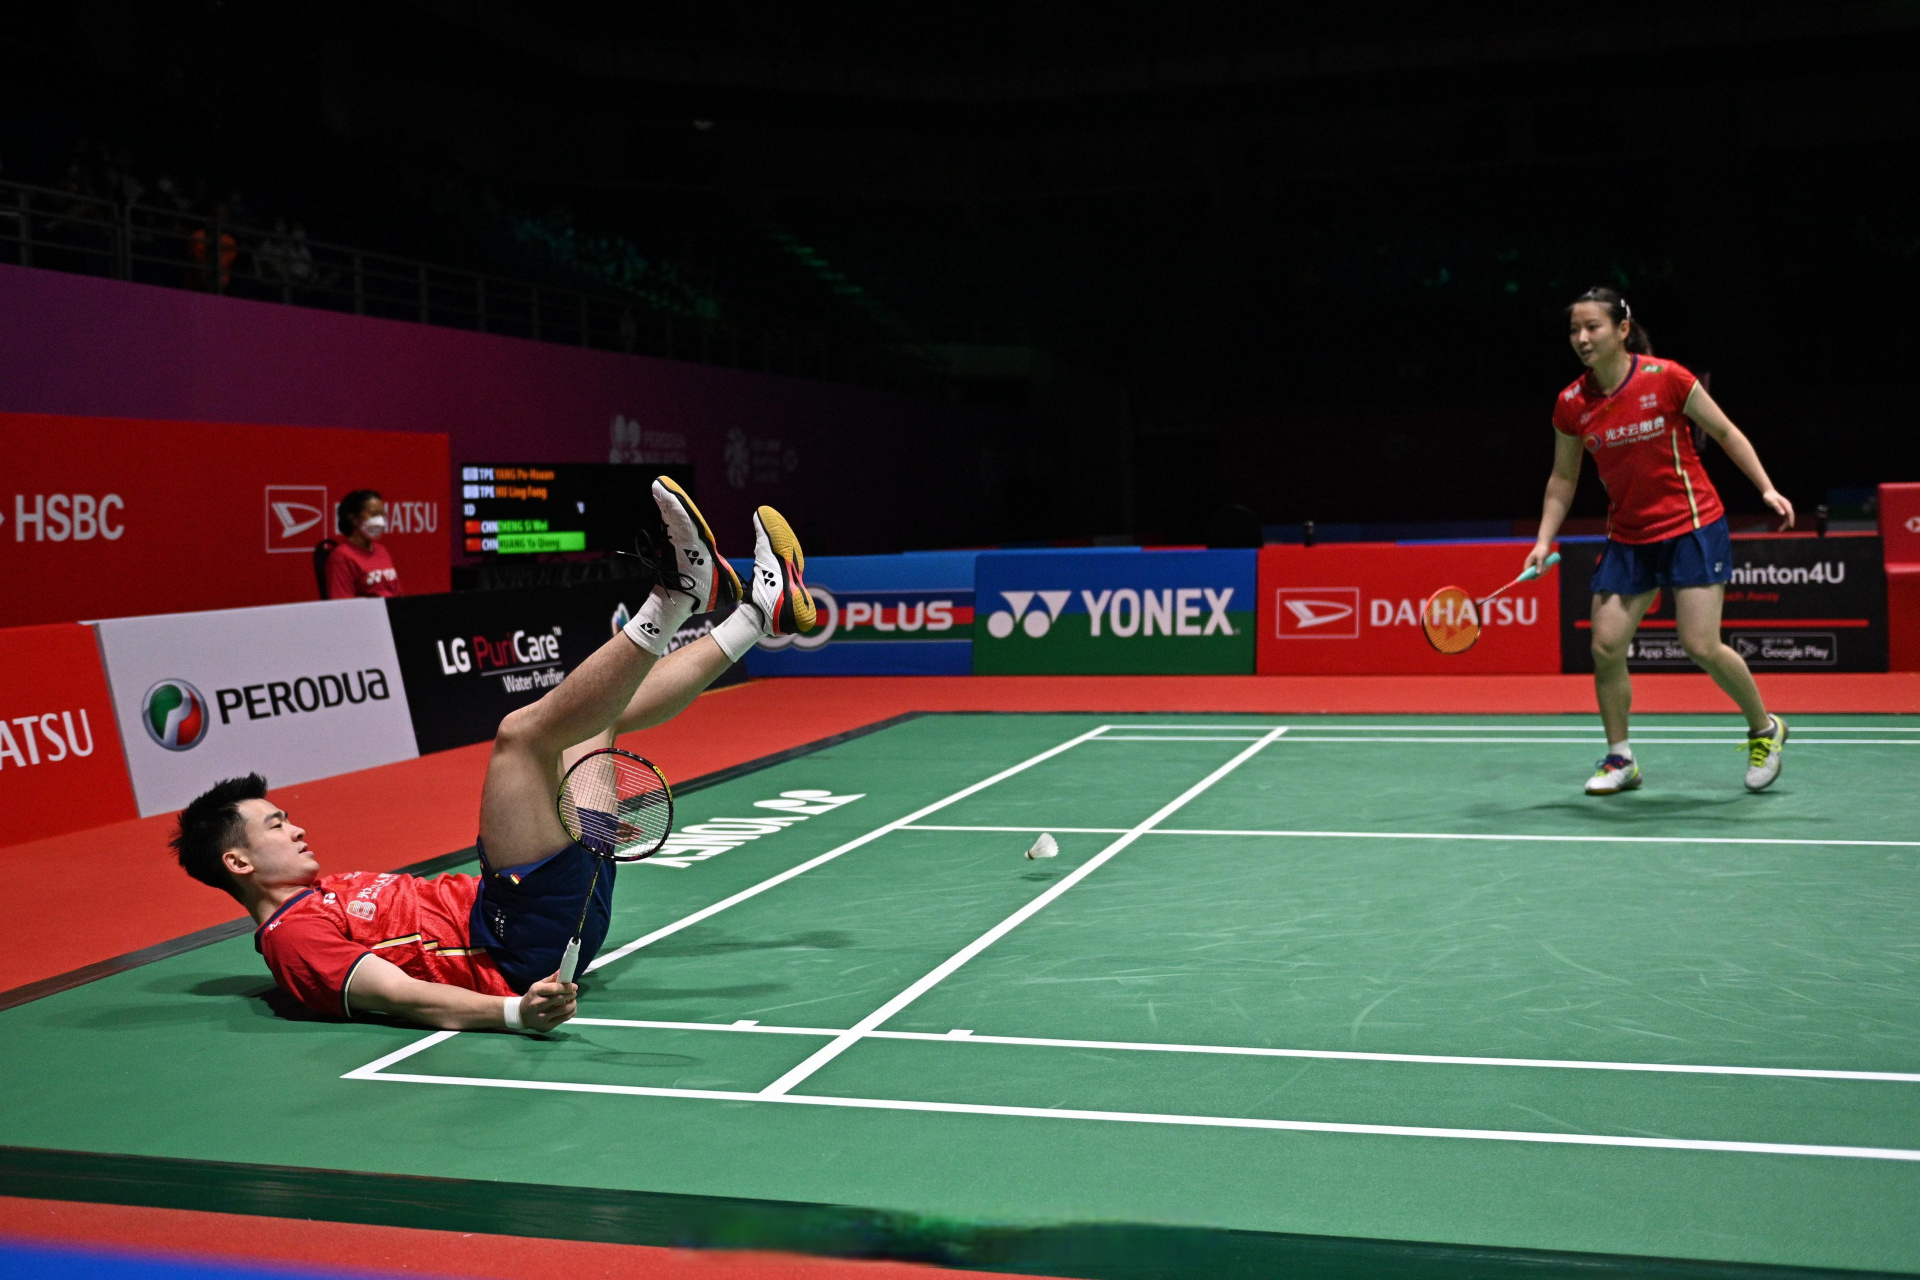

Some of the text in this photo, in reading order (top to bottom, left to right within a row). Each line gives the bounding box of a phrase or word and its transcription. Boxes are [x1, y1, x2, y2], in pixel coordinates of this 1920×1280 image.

[479, 468, 494, 480] TPE
[480, 486, 495, 498] TPE
[15, 493, 124, 542] HSBC
[481, 520, 498, 533] CHN
[482, 538, 498, 551] CHN
[1082, 589, 1234, 636] YONEX
[1371, 598, 1537, 627] DAIHATSU
[437, 637, 472, 675] LG
[1761, 645, 1829, 661] Google Play
[503, 674, 533, 693] Water
